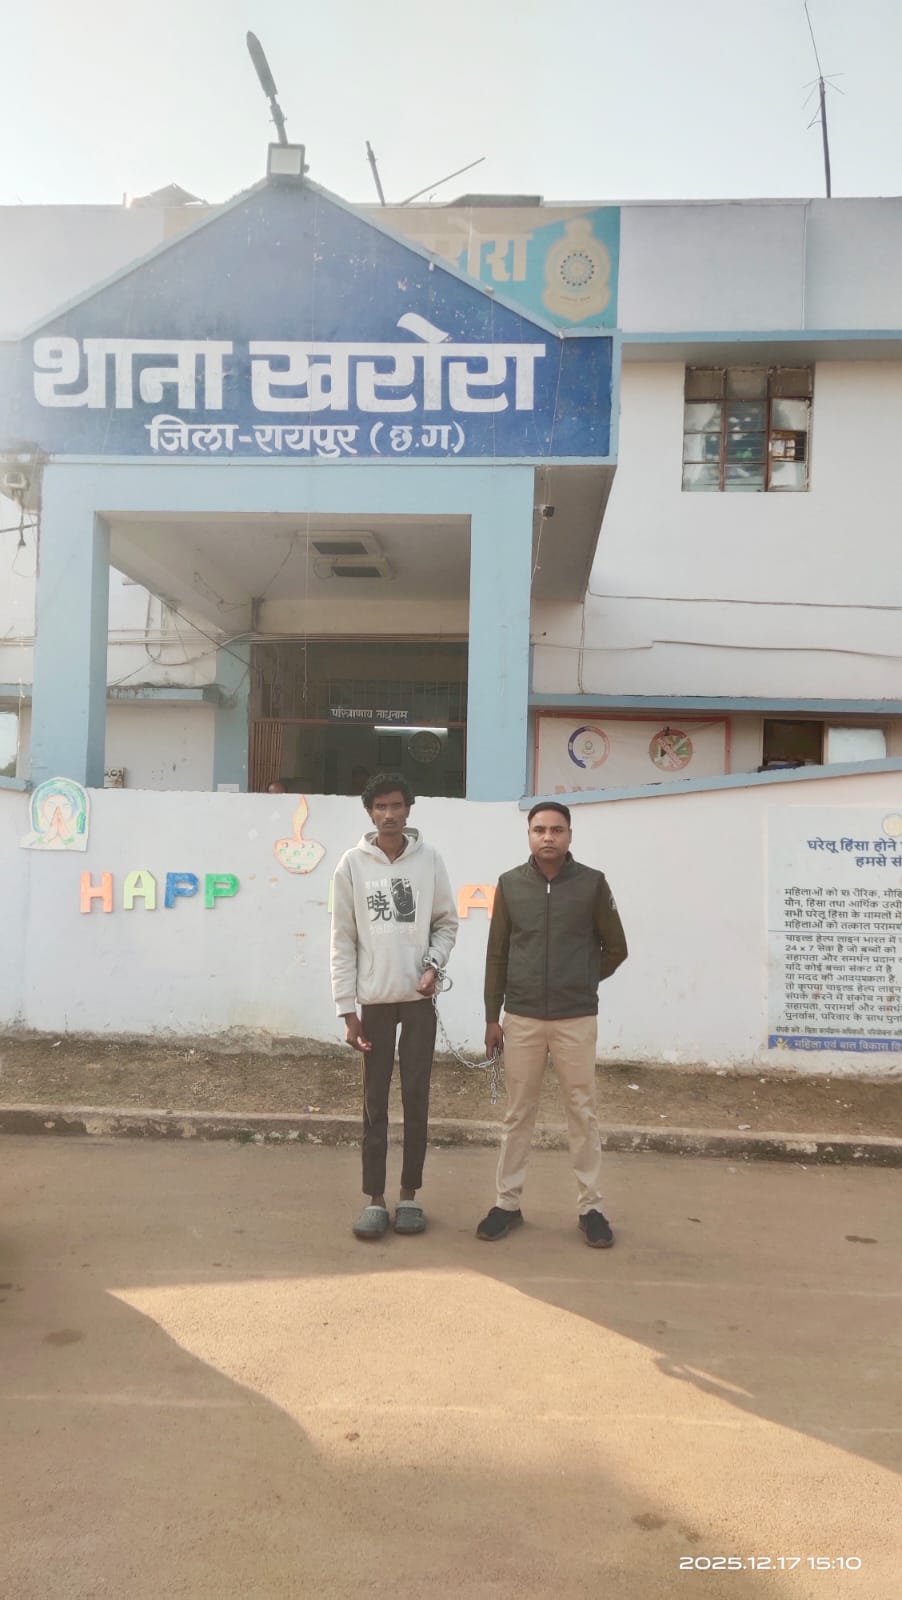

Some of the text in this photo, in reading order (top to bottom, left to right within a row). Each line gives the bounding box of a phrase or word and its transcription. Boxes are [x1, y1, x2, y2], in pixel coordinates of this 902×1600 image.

[33, 313, 545, 413] थाना खरोरा
[144, 414, 359, 457] जिला-रायपुर
[807, 837, 839, 853] घरेलू
[841, 837, 869, 851] हिंसा
[873, 837, 897, 852] होने
[855, 854, 887, 867] हमसे
[80, 869, 240, 914] HAPP
[784, 886, 823, 896] महिलाओं
[825, 886, 838, 896] को
[806, 897, 826, 907] हिंसा
[784, 908, 803, 918] सभी
[805, 909, 827, 919] घरेलू
[828, 909, 848, 919] हिंसा
[851, 909, 861, 918] के
[784, 918, 823, 929] महिलाओं
[825, 919, 838, 928] को
[840, 921, 871, 930] तत्काल
[837, 935, 860, 944] लाइन
[863, 936, 885, 944] भारत
[837, 943, 844, 953] है
[847, 944, 858, 953] जो
[884, 945, 896, 953] को
[784, 953, 818, 962] सहायता
[821, 952, 838, 962] और
[784, 962, 801, 971] यदि
[796, 973, 818, 982] मदद
[784, 981, 794, 990] तो
[798, 983, 822, 991] कृपया
[857, 1002, 875, 1011] और
[821, 1012, 850, 1021] परिवार
[853, 1012, 862, 1021] के
[794, 1038, 822, 1049] महिला
